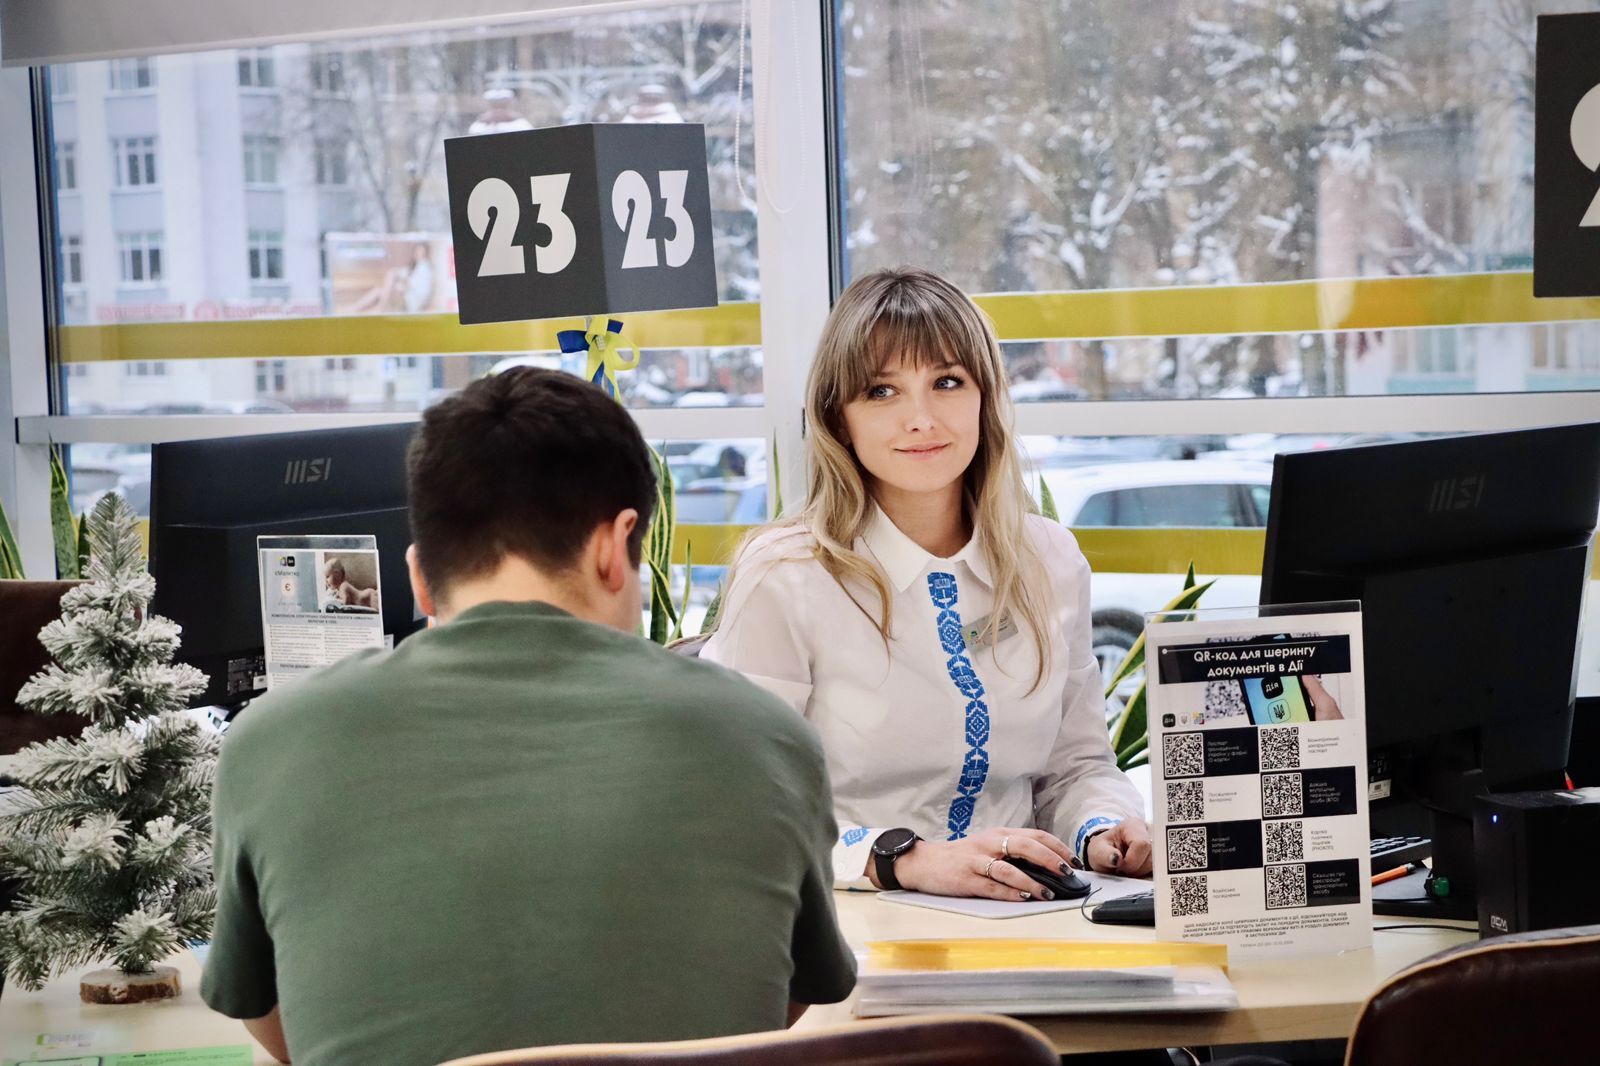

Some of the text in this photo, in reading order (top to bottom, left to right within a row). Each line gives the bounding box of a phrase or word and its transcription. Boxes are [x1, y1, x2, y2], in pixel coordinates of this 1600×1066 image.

[467, 173, 577, 277] 23
[612, 170, 695, 269] 23
[1194, 646, 1316, 662] QR-код для шерингу
[1207, 660, 1304, 677] документів в Дії
